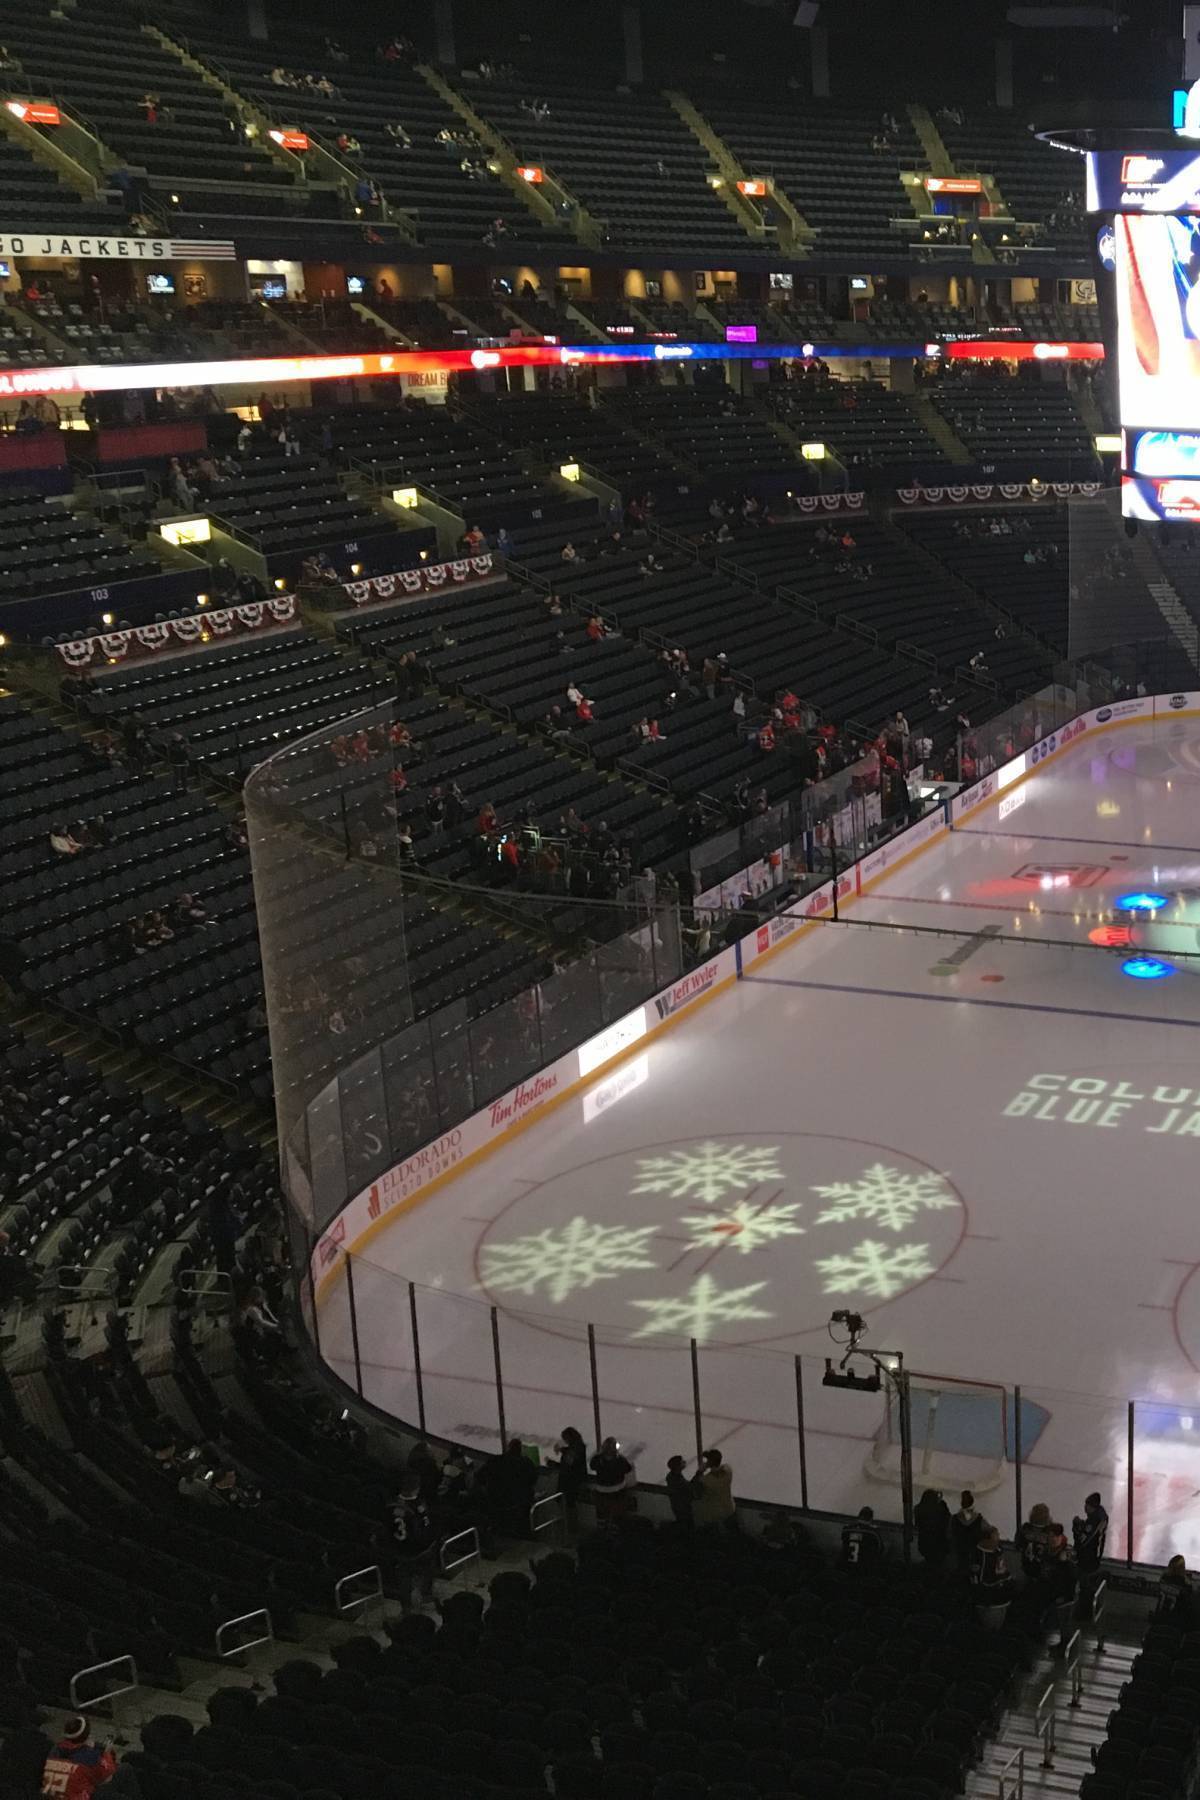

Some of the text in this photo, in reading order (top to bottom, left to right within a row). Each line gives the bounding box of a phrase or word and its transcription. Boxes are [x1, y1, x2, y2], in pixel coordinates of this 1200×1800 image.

[41, 239, 164, 257] JACKETS
[408, 373, 439, 387] DREAM
[345, 542, 358, 553] 104
[90, 588, 109, 601] 103
[672, 979, 693, 1003] Jeff
[691, 963, 719, 993] Wyler
[488, 1073, 558, 1128] Tim Hortons
[1000, 1092, 1134, 1128] BLUE
[381, 1130, 462, 1193] ELDORADO
[383, 1147, 464, 1210] SCIOTO DOWNS
[847, 1543, 859, 1563] 3
